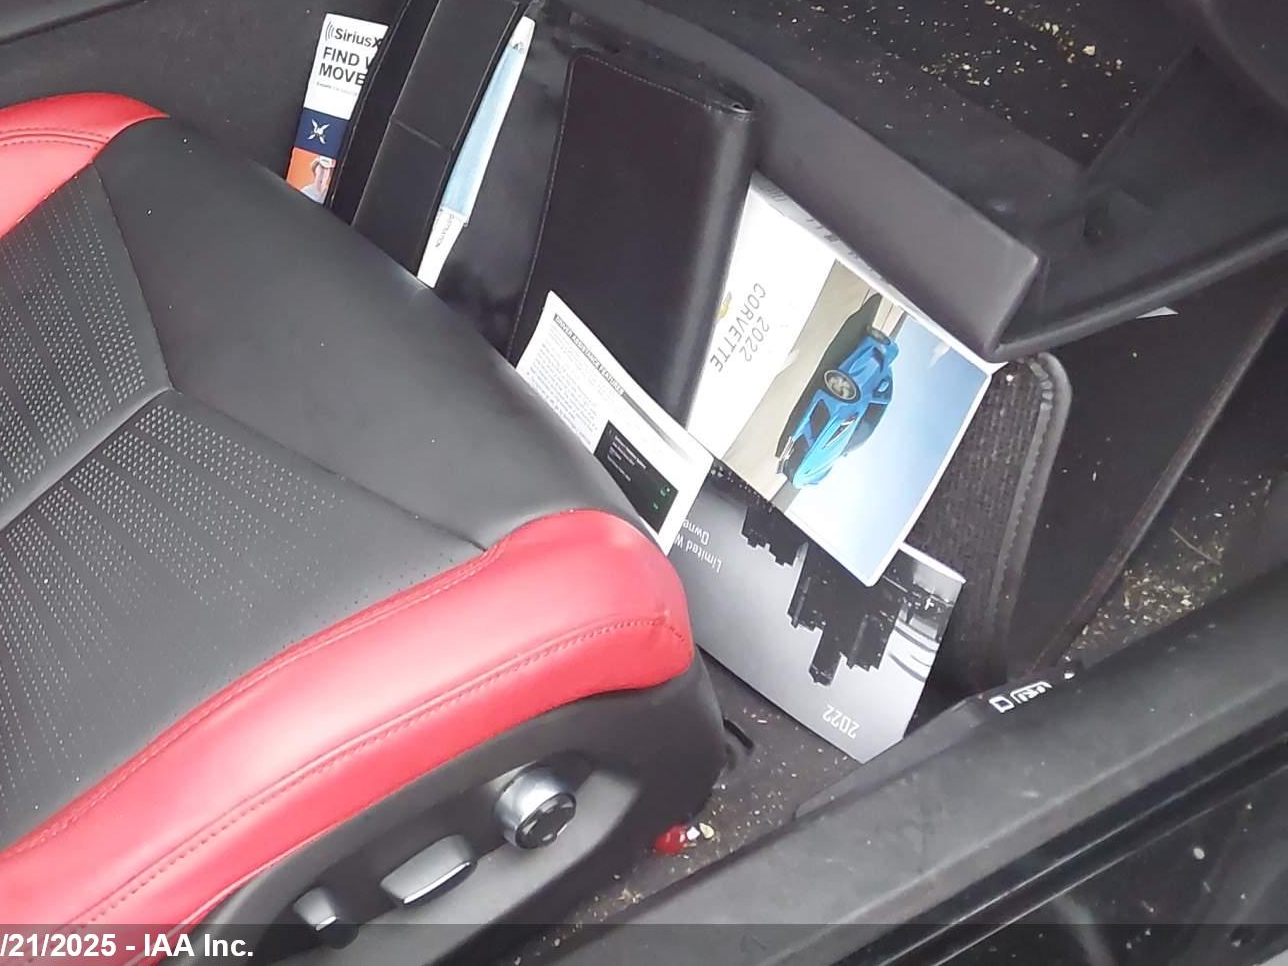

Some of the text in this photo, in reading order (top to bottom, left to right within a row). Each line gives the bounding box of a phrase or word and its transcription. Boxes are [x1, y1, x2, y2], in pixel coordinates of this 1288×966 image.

[323, 47, 360, 66] FIND
[710, 283, 766, 372] CORVETTE
[739, 316, 770, 362] 2022
[685, 540, 722, 573] Limited
[822, 704, 860, 739] 2022
